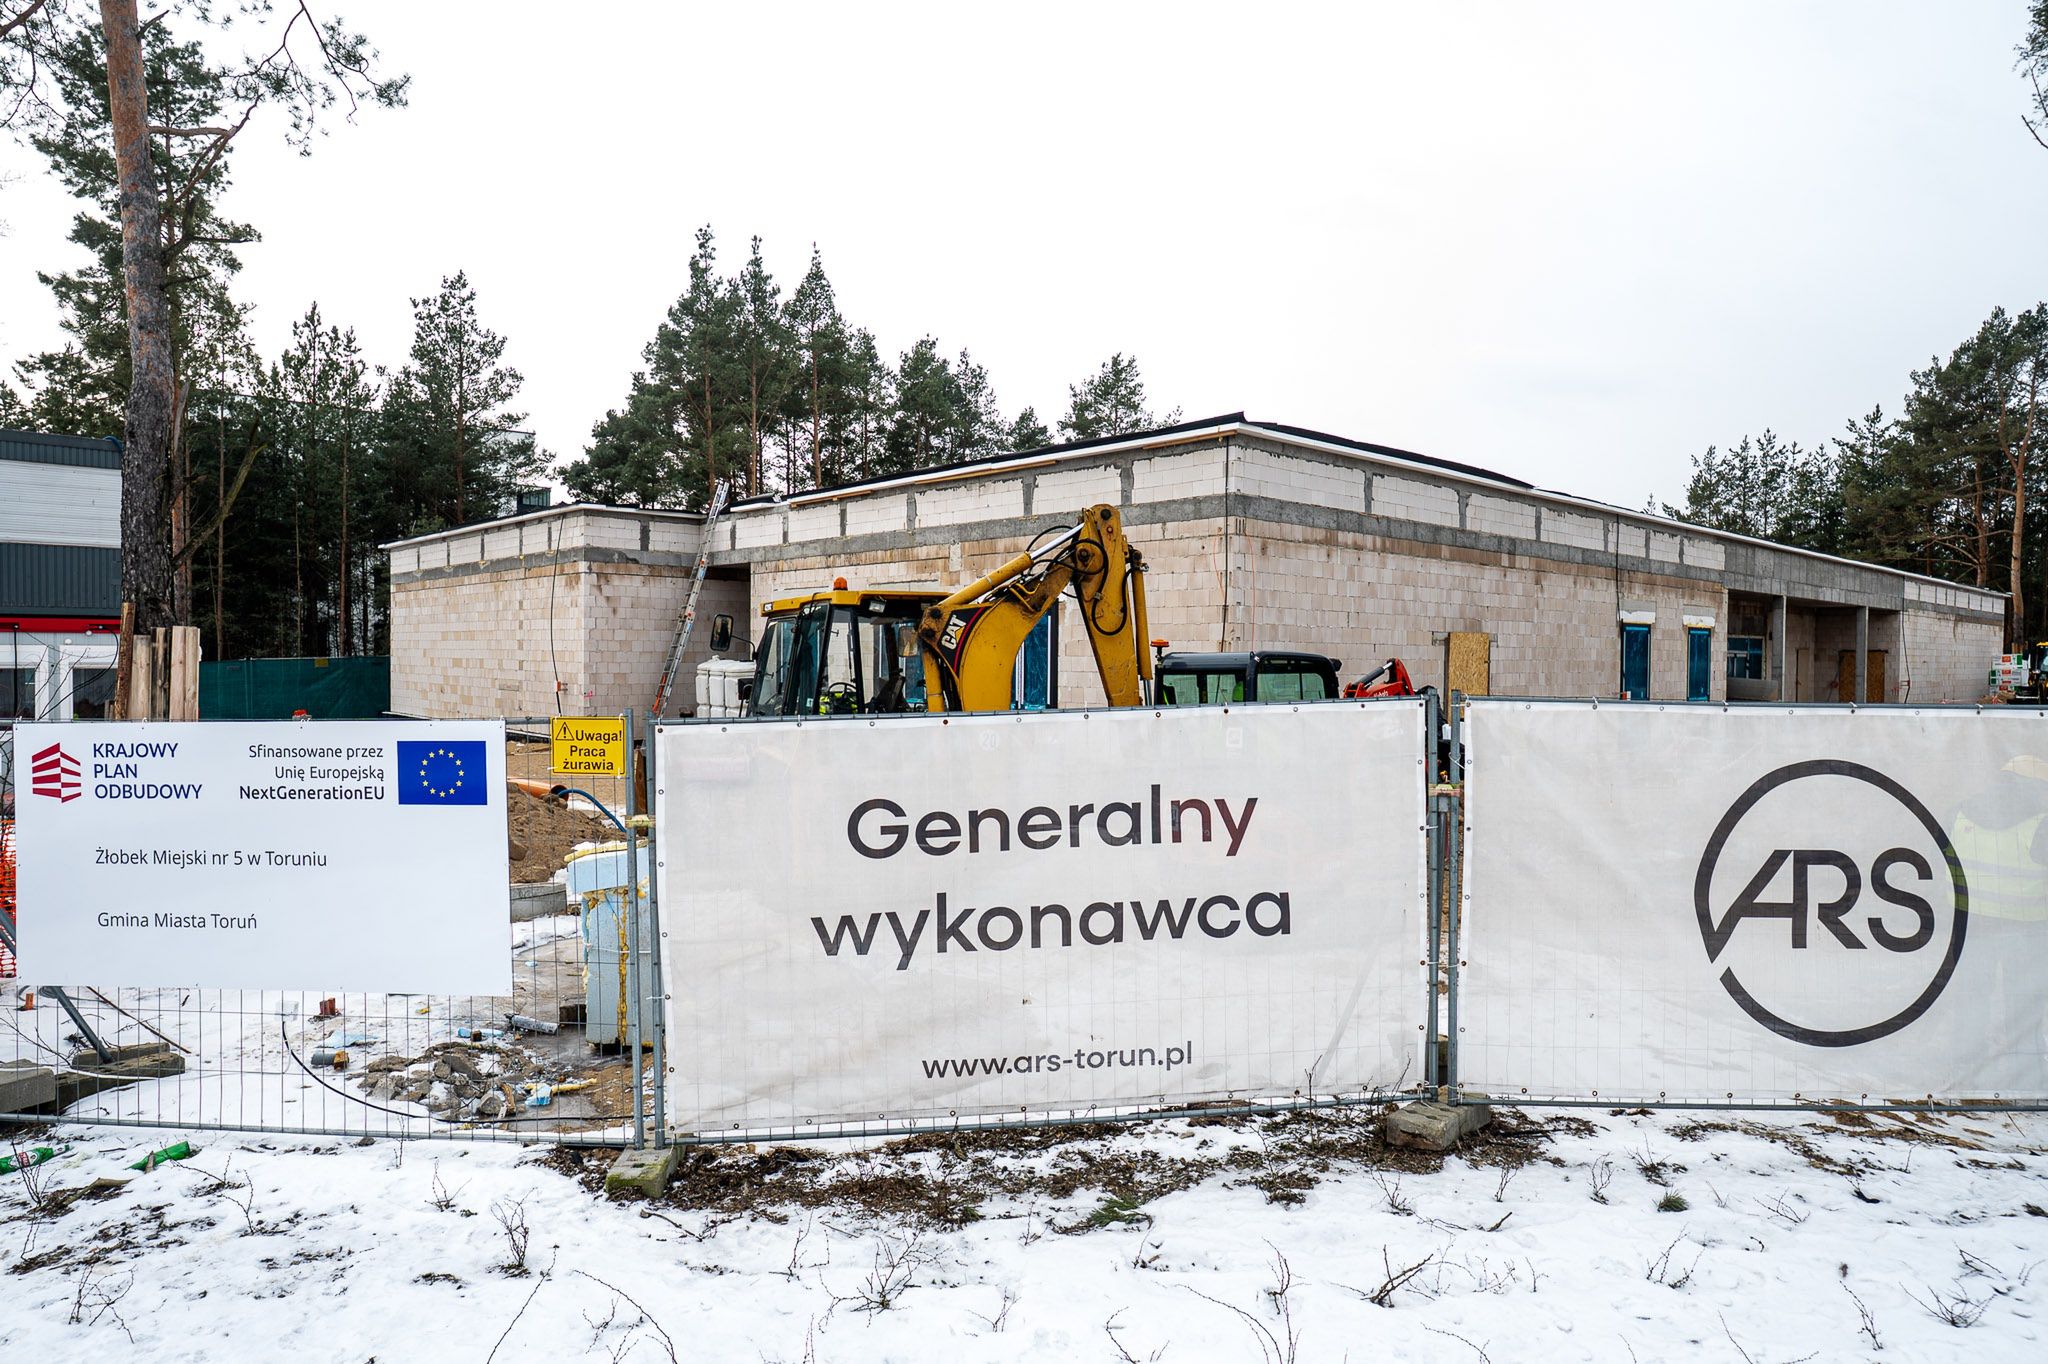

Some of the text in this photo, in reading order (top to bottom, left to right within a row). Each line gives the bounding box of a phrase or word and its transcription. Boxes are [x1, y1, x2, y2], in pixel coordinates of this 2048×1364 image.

[941, 614, 967, 650] CAT
[575, 730, 622, 745] Uwaga!
[93, 743, 179, 758] KRAJOWY
[248, 744, 384, 761] Sfinansowane przez
[569, 745, 606, 757] Praca
[93, 764, 138, 779] PLAN
[562, 758, 614, 771] żurawia
[274, 765, 385, 781] Unię Europejską
[94, 784, 203, 800] ODBUDOWY
[239, 785, 385, 800] NextGenerationEU
[847, 783, 1259, 860] Generalny
[95, 846, 327, 869] Żłobek Miejski nr 5 w Toruniu
[1712, 847, 1935, 953] ARS
[97, 911, 257, 929] Gmina Miasta Toruń
[811, 891, 1291, 970] wykonawca
[921, 1040, 1193, 1080] www.ars-torun.pl
